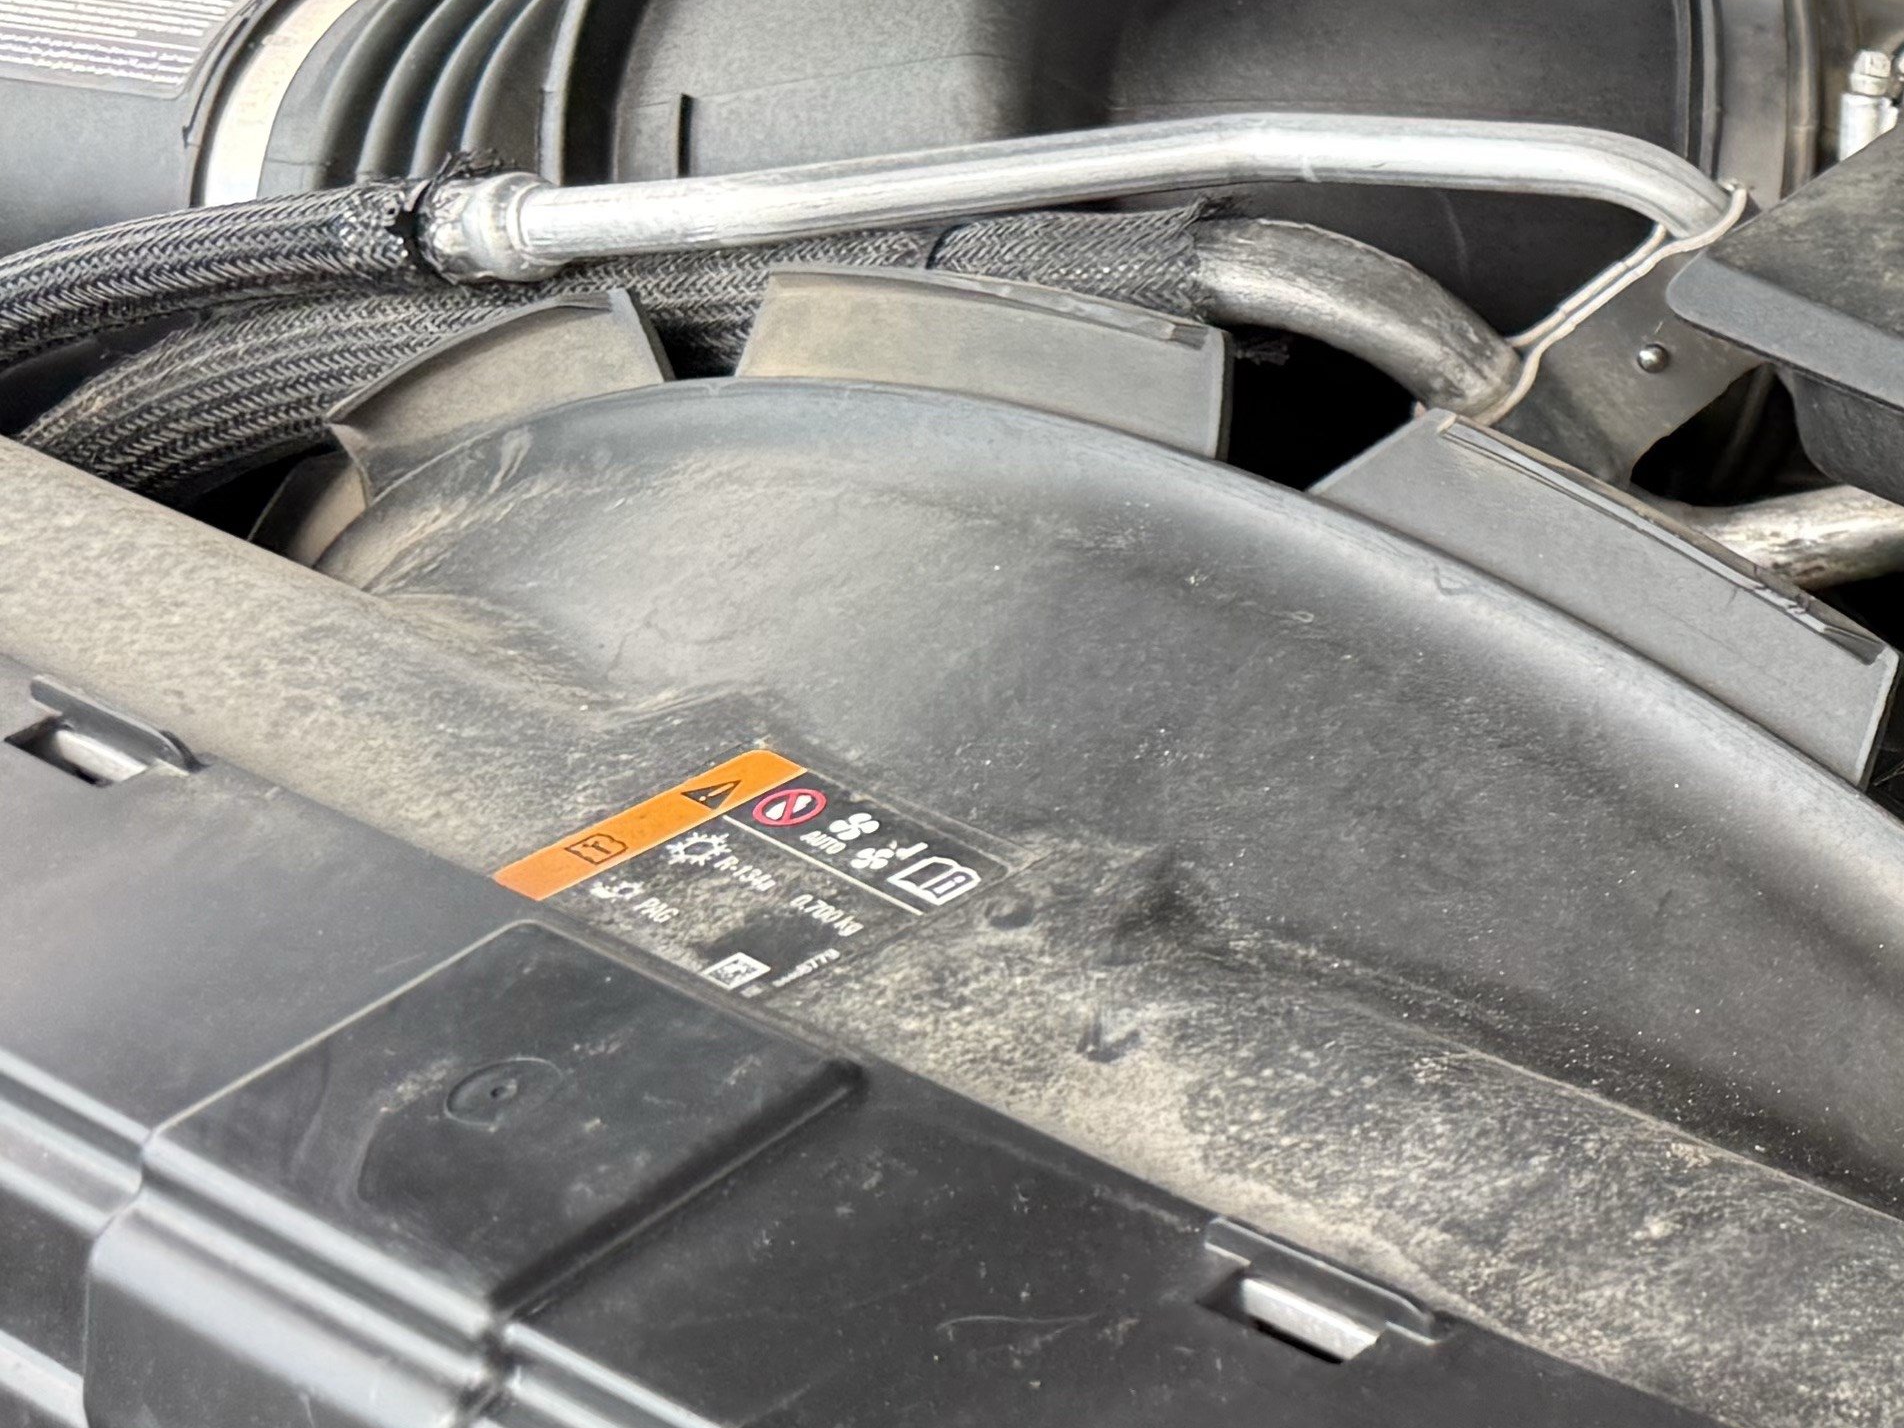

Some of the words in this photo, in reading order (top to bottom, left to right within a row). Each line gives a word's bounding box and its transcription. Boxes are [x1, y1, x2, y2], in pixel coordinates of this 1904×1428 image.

[799, 830, 847, 855] AUTO
[634, 896, 680, 924] PAG
[713, 856, 776, 892] R-134a
[789, 893, 846, 925] 0.700
[833, 914, 865, 938] kg
